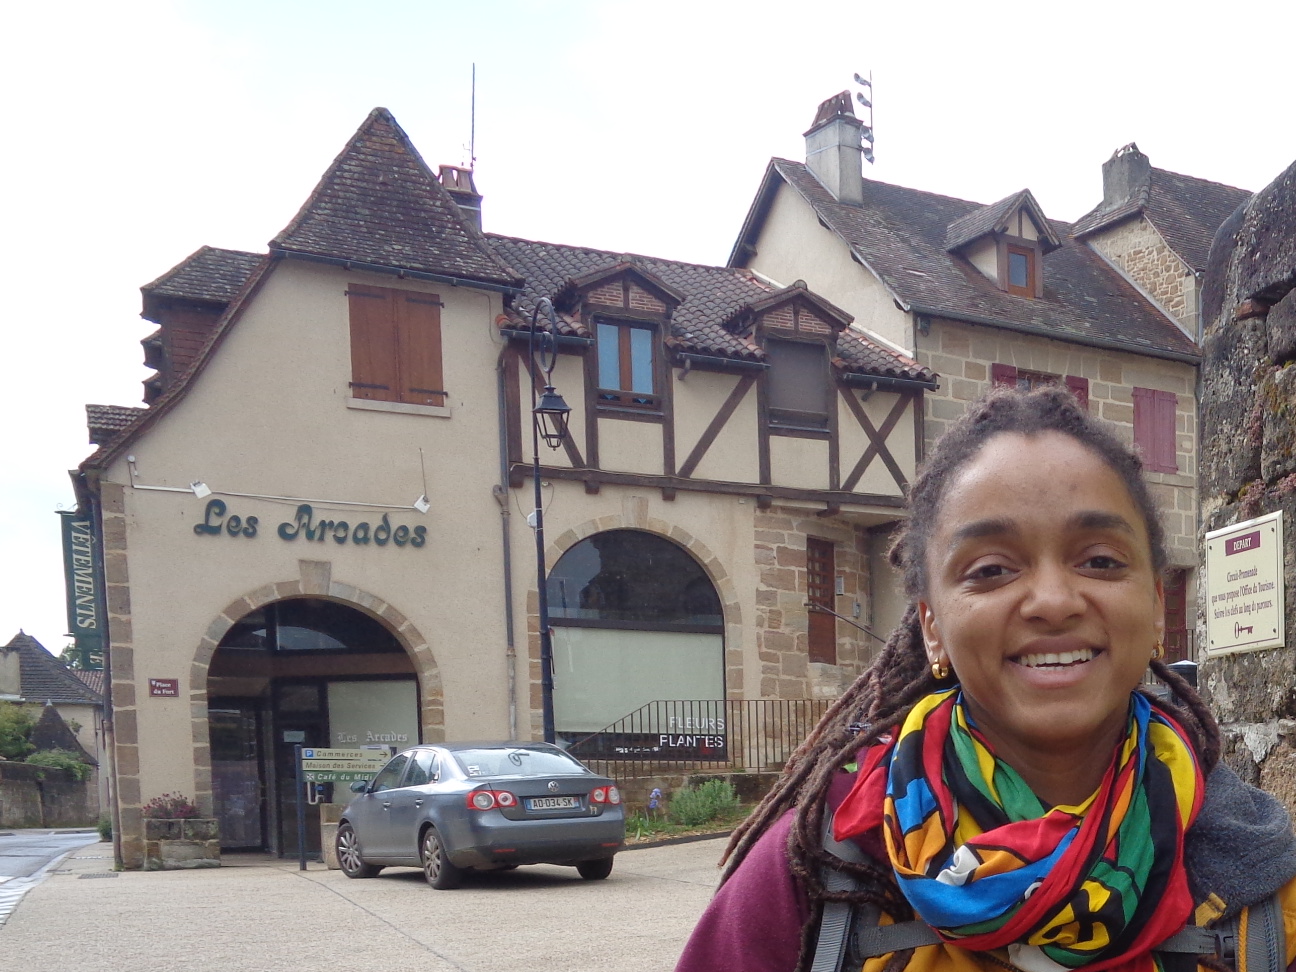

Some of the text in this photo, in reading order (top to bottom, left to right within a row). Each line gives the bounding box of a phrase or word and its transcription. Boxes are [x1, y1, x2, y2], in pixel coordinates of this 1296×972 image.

[193, 498, 427, 548] Les Arcades
[1233, 537, 1252, 551] DEPART
[71, 520, 97, 629] VÊTEMENTS
[1218, 592, 1226, 601] vous
[1226, 589, 1239, 603] propose
[1252, 585, 1258, 595] du
[669, 717, 725, 730] FLEURS
[337, 731, 408, 743] Les Arcades
[354, 773, 373, 781] Midi
